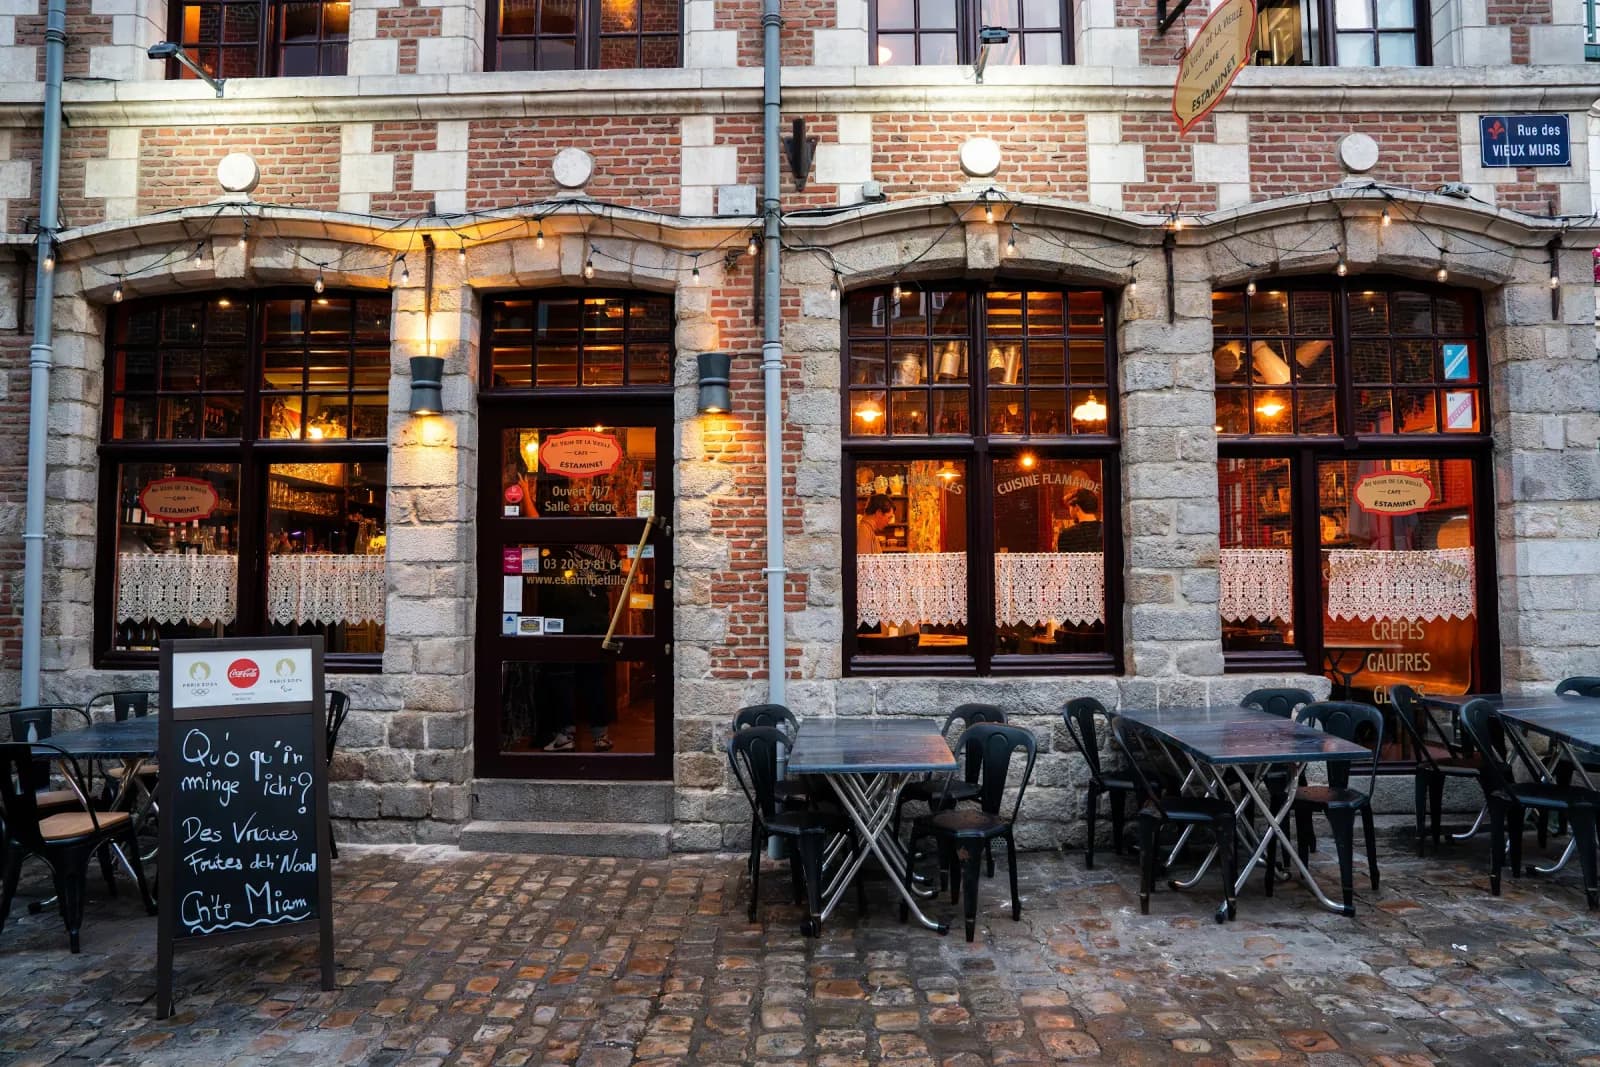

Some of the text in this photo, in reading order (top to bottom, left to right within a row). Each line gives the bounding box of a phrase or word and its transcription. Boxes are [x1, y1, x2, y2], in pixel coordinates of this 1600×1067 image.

[1206, 32, 1213, 48] DE
[1214, 24, 1222, 38] LA
[1192, 54, 1236, 112] ESTAMINET
[1518, 124, 1560, 136] Rue des
[1492, 144, 1561, 156] VIEUX MURS
[560, 460, 603, 468] ESTAMINET
[552, 486, 610, 499] Ouvert 7j/7
[996, 474, 1101, 495] CUISINE FLAMANDE
[544, 500, 570, 512] Salle
[584, 500, 618, 514] l'étage
[1374, 500, 1416, 508] ESTAMINET
[544, 558, 557, 570] 03
[560, 558, 574, 570] 20
[580, 559, 590, 570] 13
[594, 559, 606, 570] 81
[610, 559, 622, 570] 64
[1367, 652, 1431, 672] GAUFRES
[230, 668, 258, 678] Coca-Cola
[1374, 685, 1425, 704] GLES
[181, 771, 312, 814] minge ichi?
[182, 812, 298, 844] Des Vraies
[181, 881, 307, 926] Ch'ti Miam
